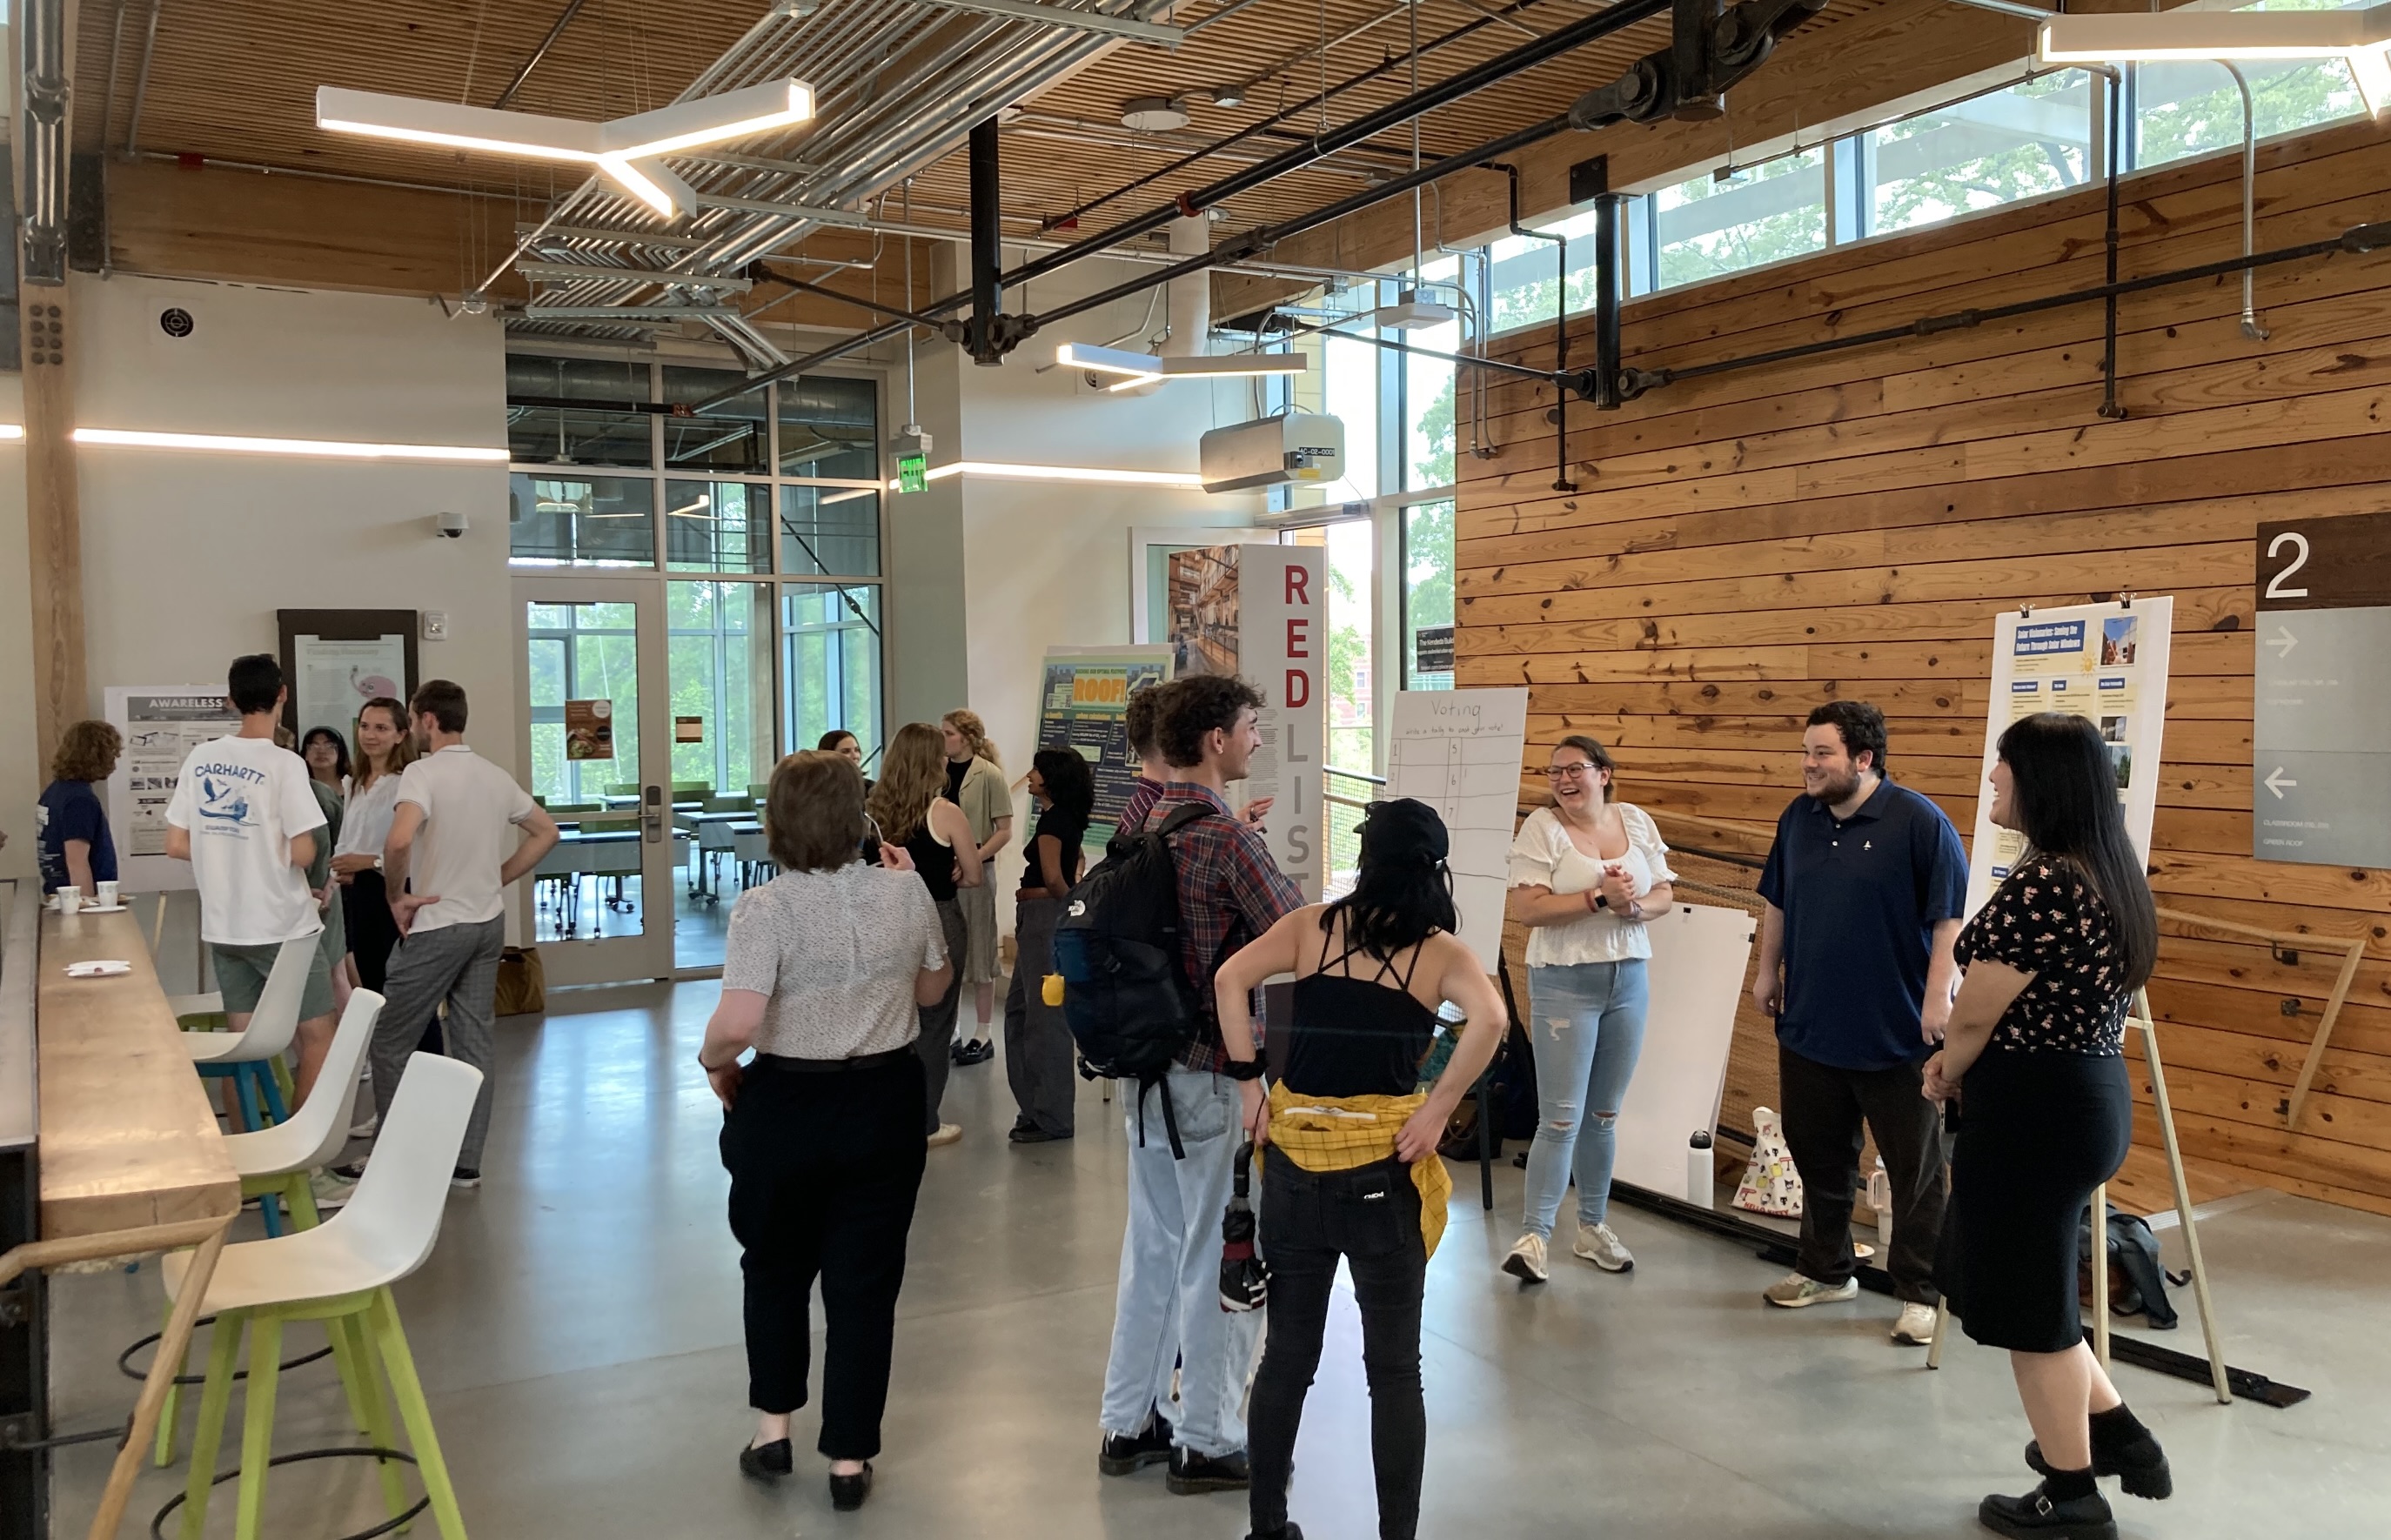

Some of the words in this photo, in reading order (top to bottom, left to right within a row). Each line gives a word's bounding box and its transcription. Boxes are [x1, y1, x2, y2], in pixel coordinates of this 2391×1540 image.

[2265, 532, 2309, 599] 2
[1285, 565, 1309, 708] RED
[1073, 678, 1127, 702] ROOF!
[149, 699, 223, 708] AWARELESS
[1431, 700, 1481, 729] Voting
[1431, 726, 1444, 736] tally
[1393, 744, 1397, 756] 1
[1452, 745, 1457, 753] 5
[195, 763, 265, 784] CARHARTT
[1390, 773, 1395, 781] 2
[1451, 773, 1457, 785] 6
[1449, 807, 1454, 818] 7
[1744, 1202, 1765, 1213] HELLO
